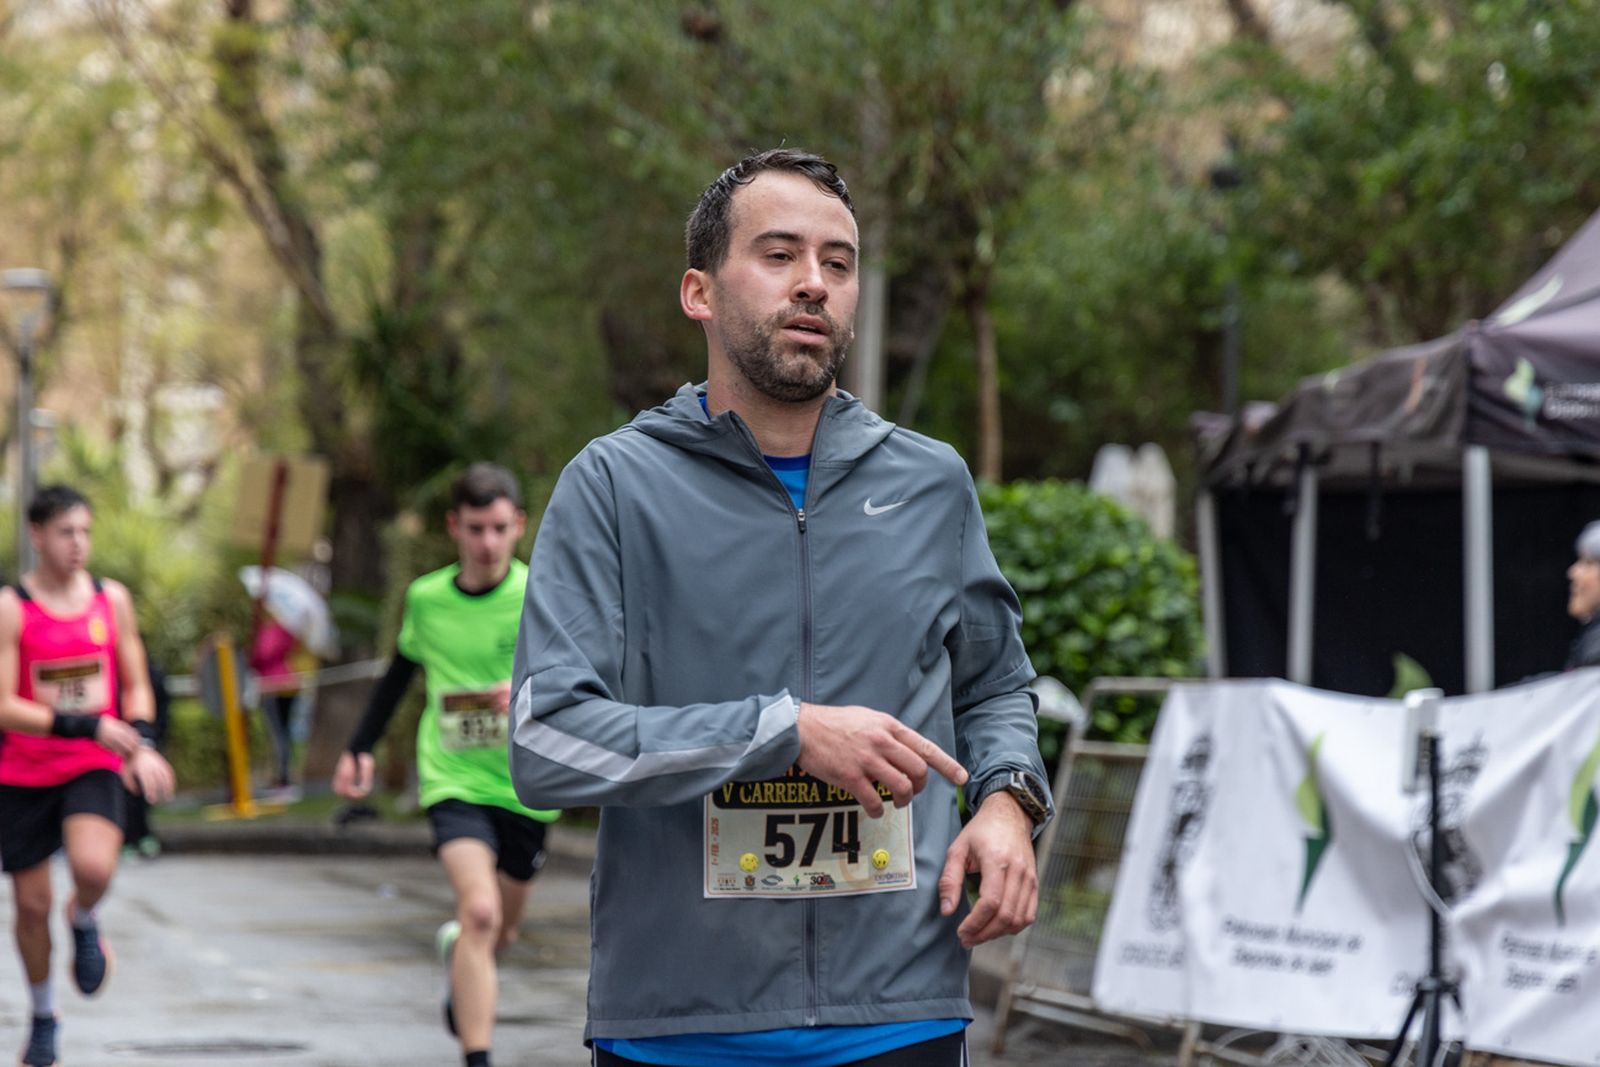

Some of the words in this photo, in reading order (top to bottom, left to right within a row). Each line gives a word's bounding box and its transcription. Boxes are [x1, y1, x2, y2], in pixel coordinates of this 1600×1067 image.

[723, 783, 735, 802] V
[739, 783, 820, 804] CARRERA
[764, 810, 861, 868] 574
